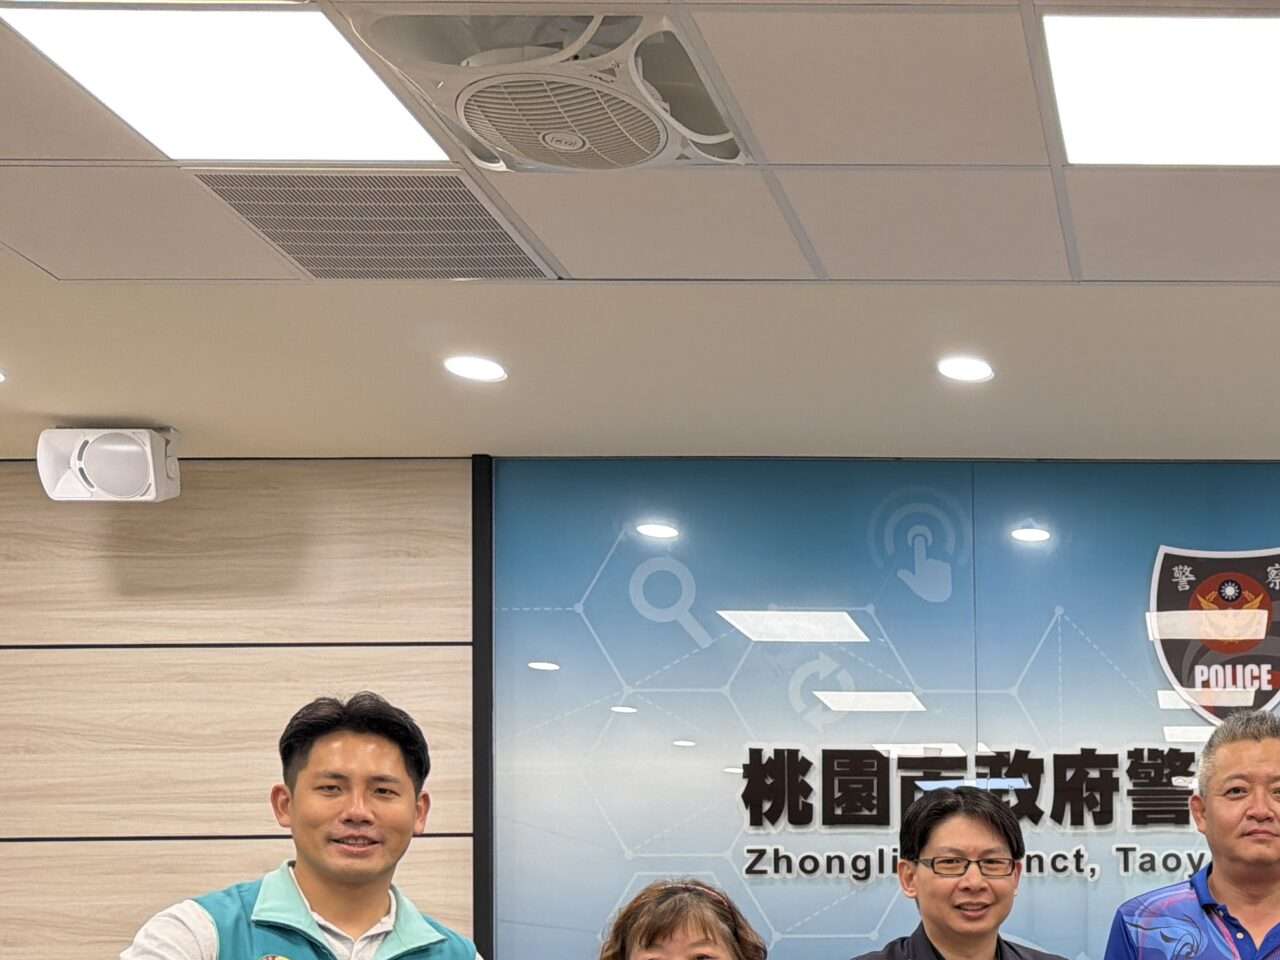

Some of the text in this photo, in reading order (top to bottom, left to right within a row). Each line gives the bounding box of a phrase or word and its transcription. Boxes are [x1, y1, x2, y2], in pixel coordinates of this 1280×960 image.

[1171, 564, 1197, 592] 警
[1194, 663, 1274, 691] POLICE
[745, 847, 899, 881] Zhongli
[1116, 846, 1206, 878] Taoy
